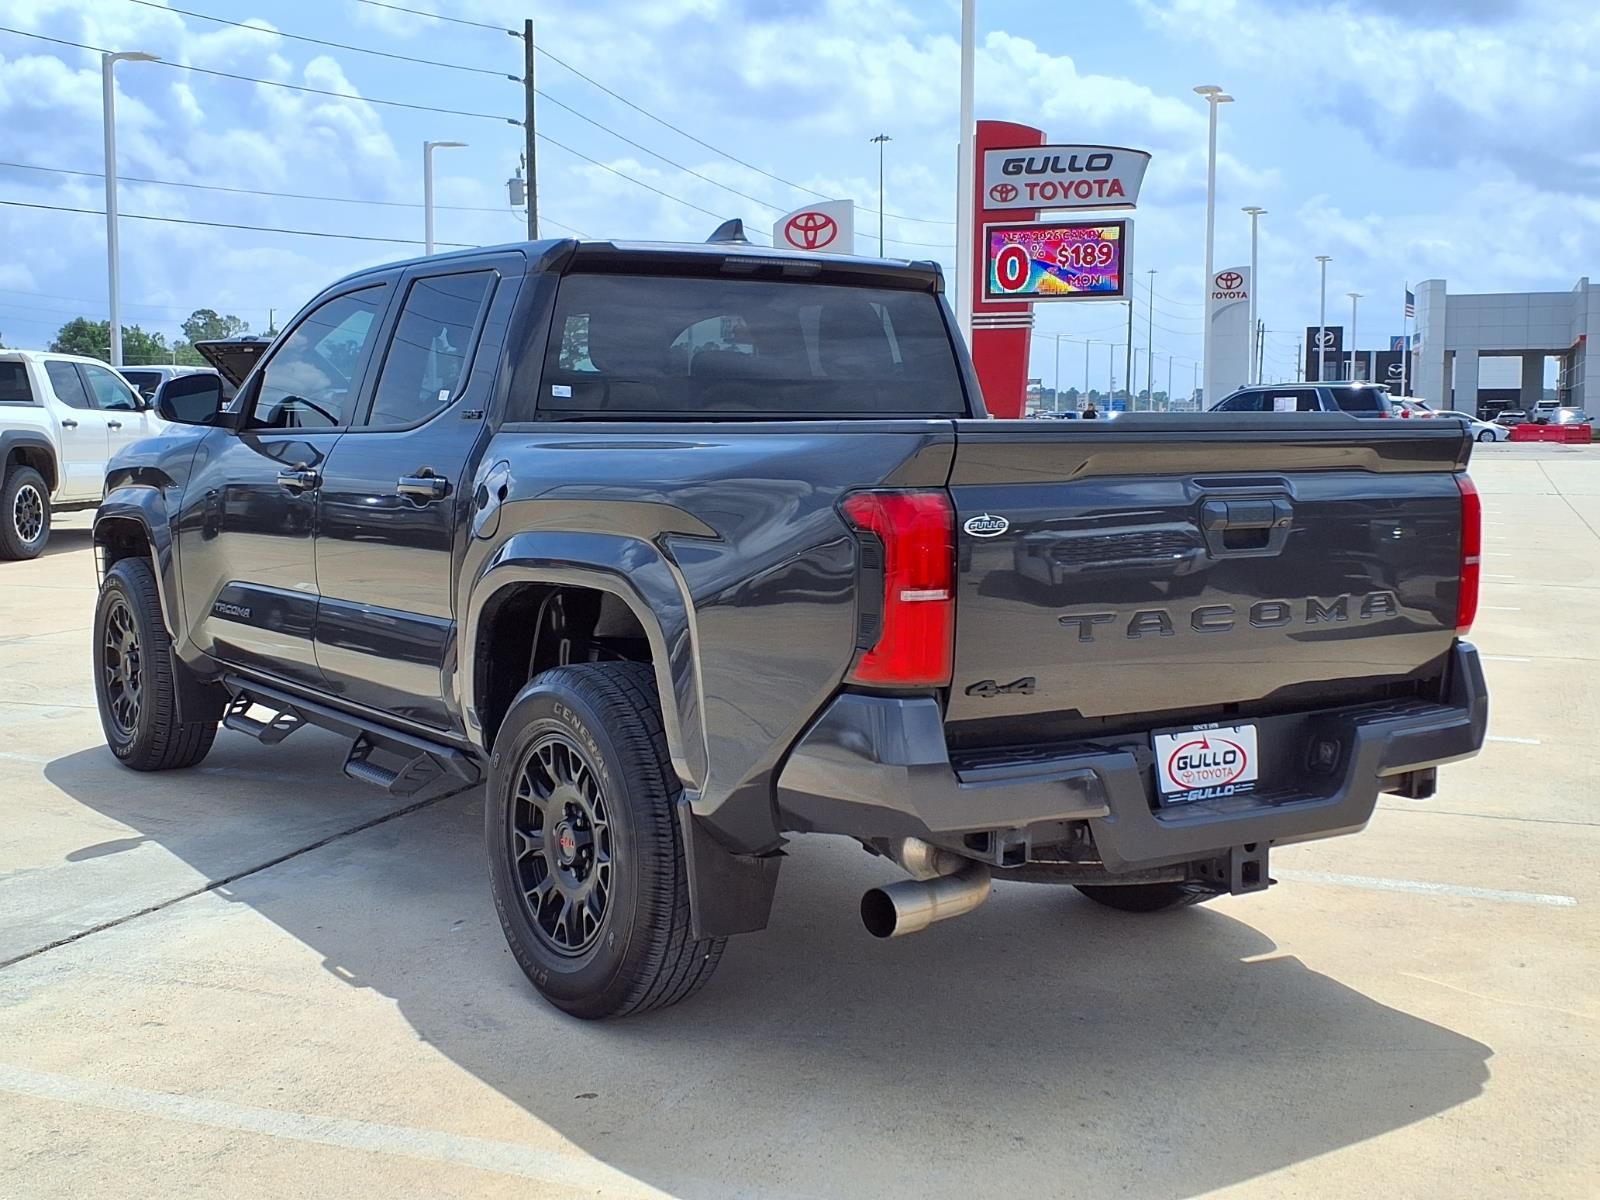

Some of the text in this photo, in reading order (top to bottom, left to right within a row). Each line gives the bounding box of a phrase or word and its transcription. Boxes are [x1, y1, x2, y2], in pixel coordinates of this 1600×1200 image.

[1002, 153, 1113, 176] GULLO
[1024, 179, 1125, 201] TOYOTA
[1056, 242, 1114, 269] $189
[1211, 291, 1248, 300] TOYOTA
[215, 602, 251, 618] TACOMA
[1058, 590, 1397, 642] TACOMA
[1177, 750, 1236, 770] GULLO
[1197, 768, 1233, 780] TOYOTA
[1187, 785, 1235, 801] GULLO
